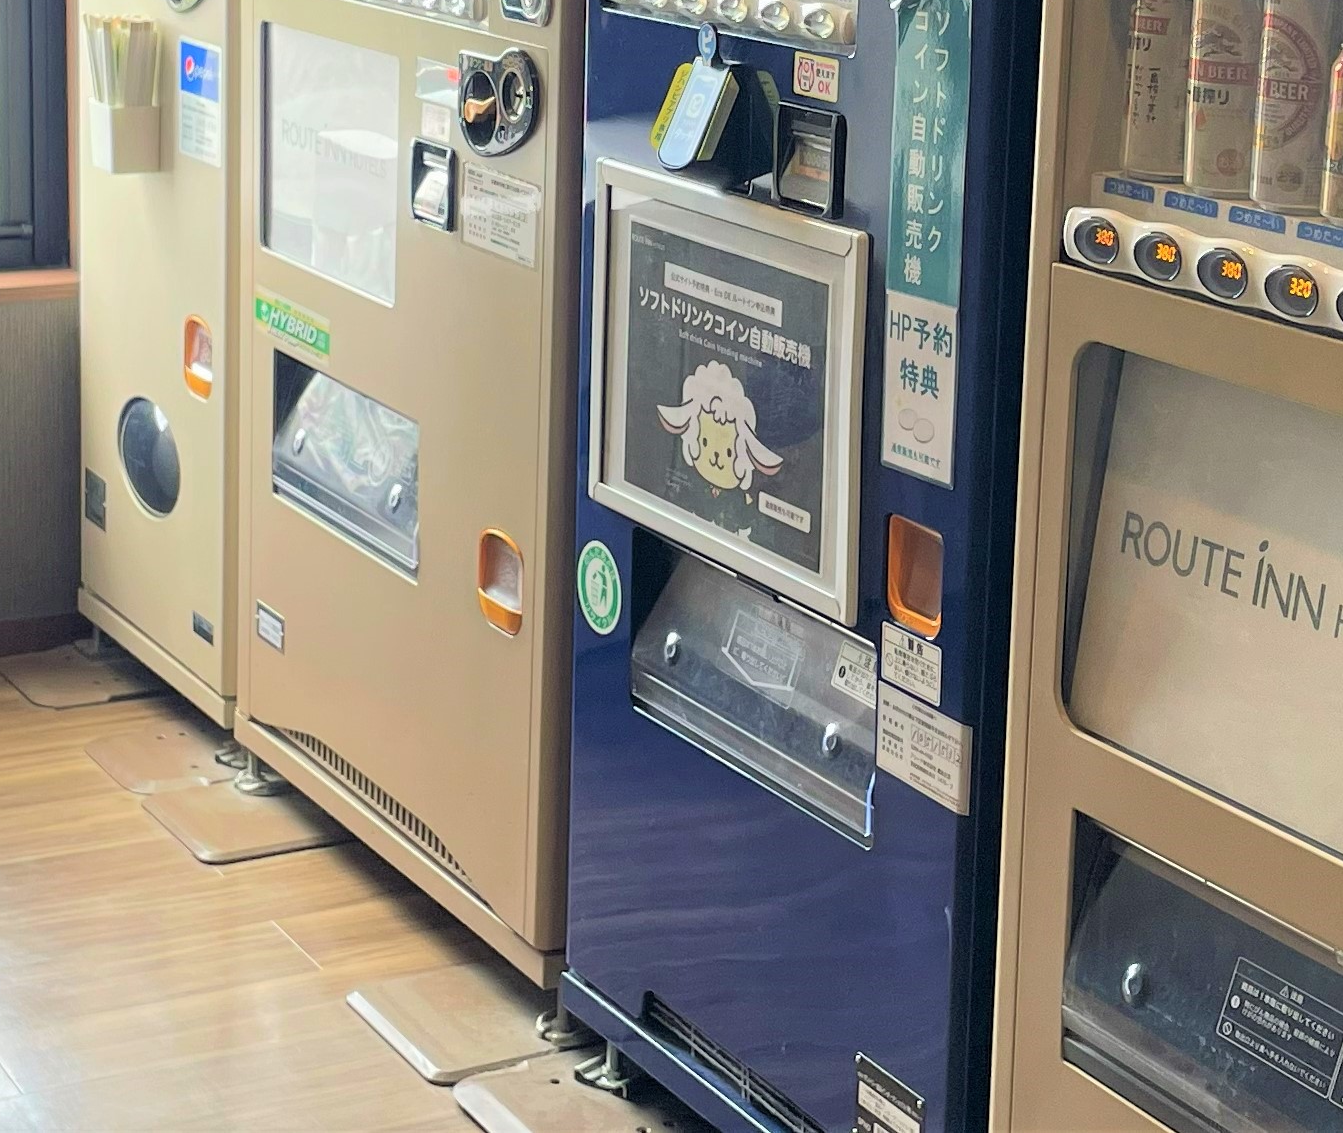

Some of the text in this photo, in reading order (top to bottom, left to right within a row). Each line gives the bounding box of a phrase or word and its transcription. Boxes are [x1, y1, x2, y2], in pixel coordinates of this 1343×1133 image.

[817, 80, 831, 95] OK
[1271, 81, 1309, 100] BEER
[903, 11, 929, 286] コイン自動販売機
[927, 11, 950, 253] ソフトドリンク
[1095, 229, 1114, 245] 380
[1156, 244, 1175, 261] 380
[1221, 261, 1242, 279] 380
[1289, 278, 1312, 296] 320
[269, 306, 317, 345] HYBRID
[639, 286, 812, 369] ソフトドリンクコイン自動販売機
[889, 309, 953, 358] HP予約
[900, 358, 940, 399] 特典
[1120, 510, 1246, 599] ROUTE
